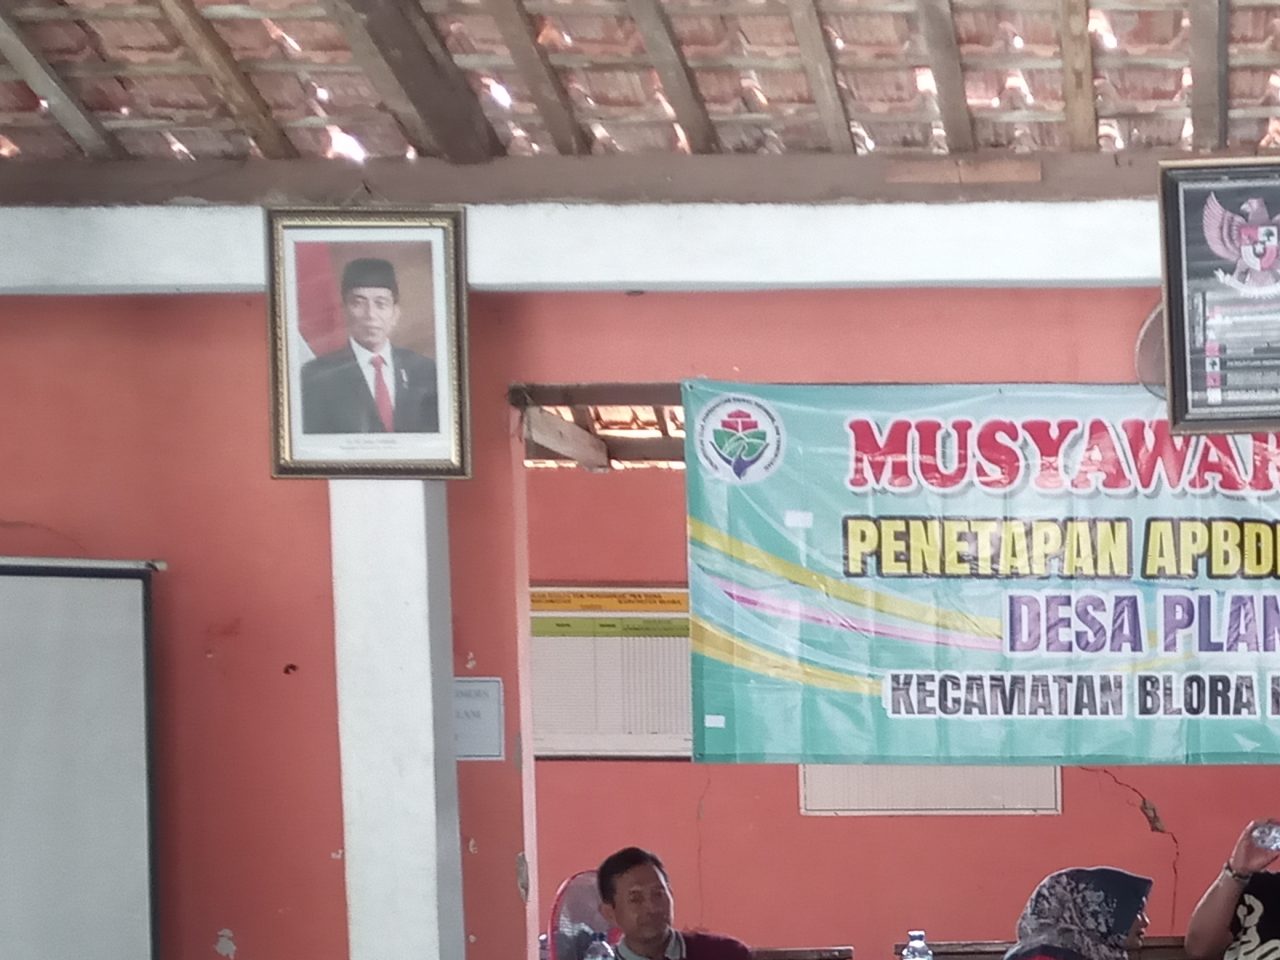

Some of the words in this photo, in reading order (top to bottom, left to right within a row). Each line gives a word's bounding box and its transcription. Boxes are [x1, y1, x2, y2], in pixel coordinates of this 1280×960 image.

[844, 517, 1131, 578] PENETAPAN
[1009, 594, 1143, 653] DESA
[891, 674, 1123, 715] KECAMATAN
[1139, 674, 1256, 715] BLORA
